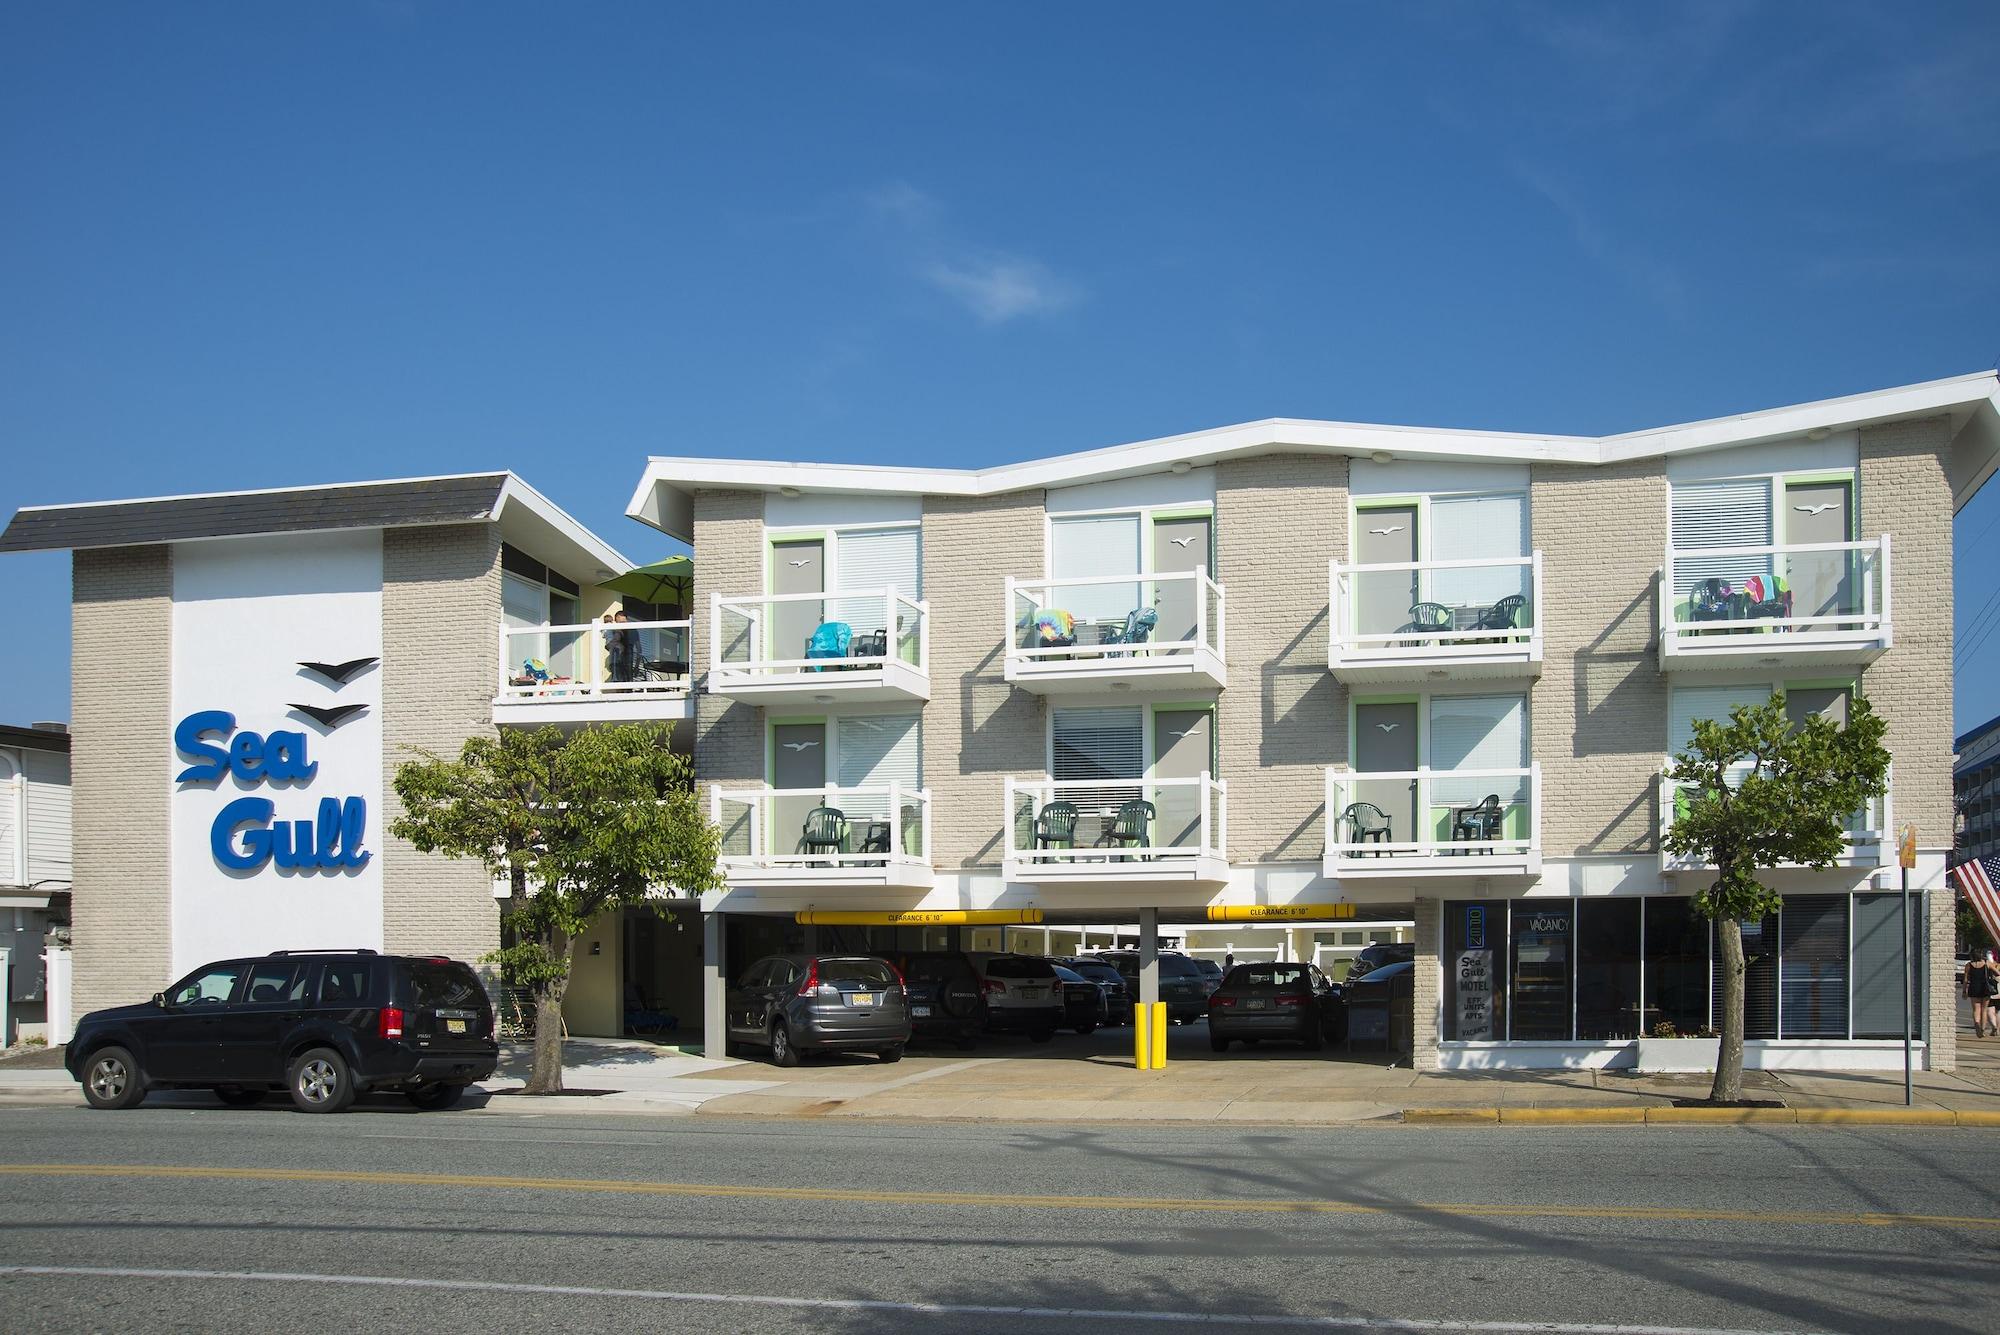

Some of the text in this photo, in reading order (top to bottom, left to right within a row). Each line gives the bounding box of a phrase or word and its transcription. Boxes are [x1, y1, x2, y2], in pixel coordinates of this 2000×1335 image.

[175, 710, 319, 781] Sea
[211, 796, 372, 870] Gull
[1250, 908, 1288, 916] CLEARANCE
[888, 914, 923, 922] CLEARANCE
[1470, 909, 1482, 945] OPEN
[1529, 918, 1570, 932] VACANCY
[1461, 957, 1482, 967] Sea
[1461, 968, 1486, 978] Gull
[1460, 981, 1489, 992] MOTEL
[1461, 1026, 1489, 1037] VACANCY
